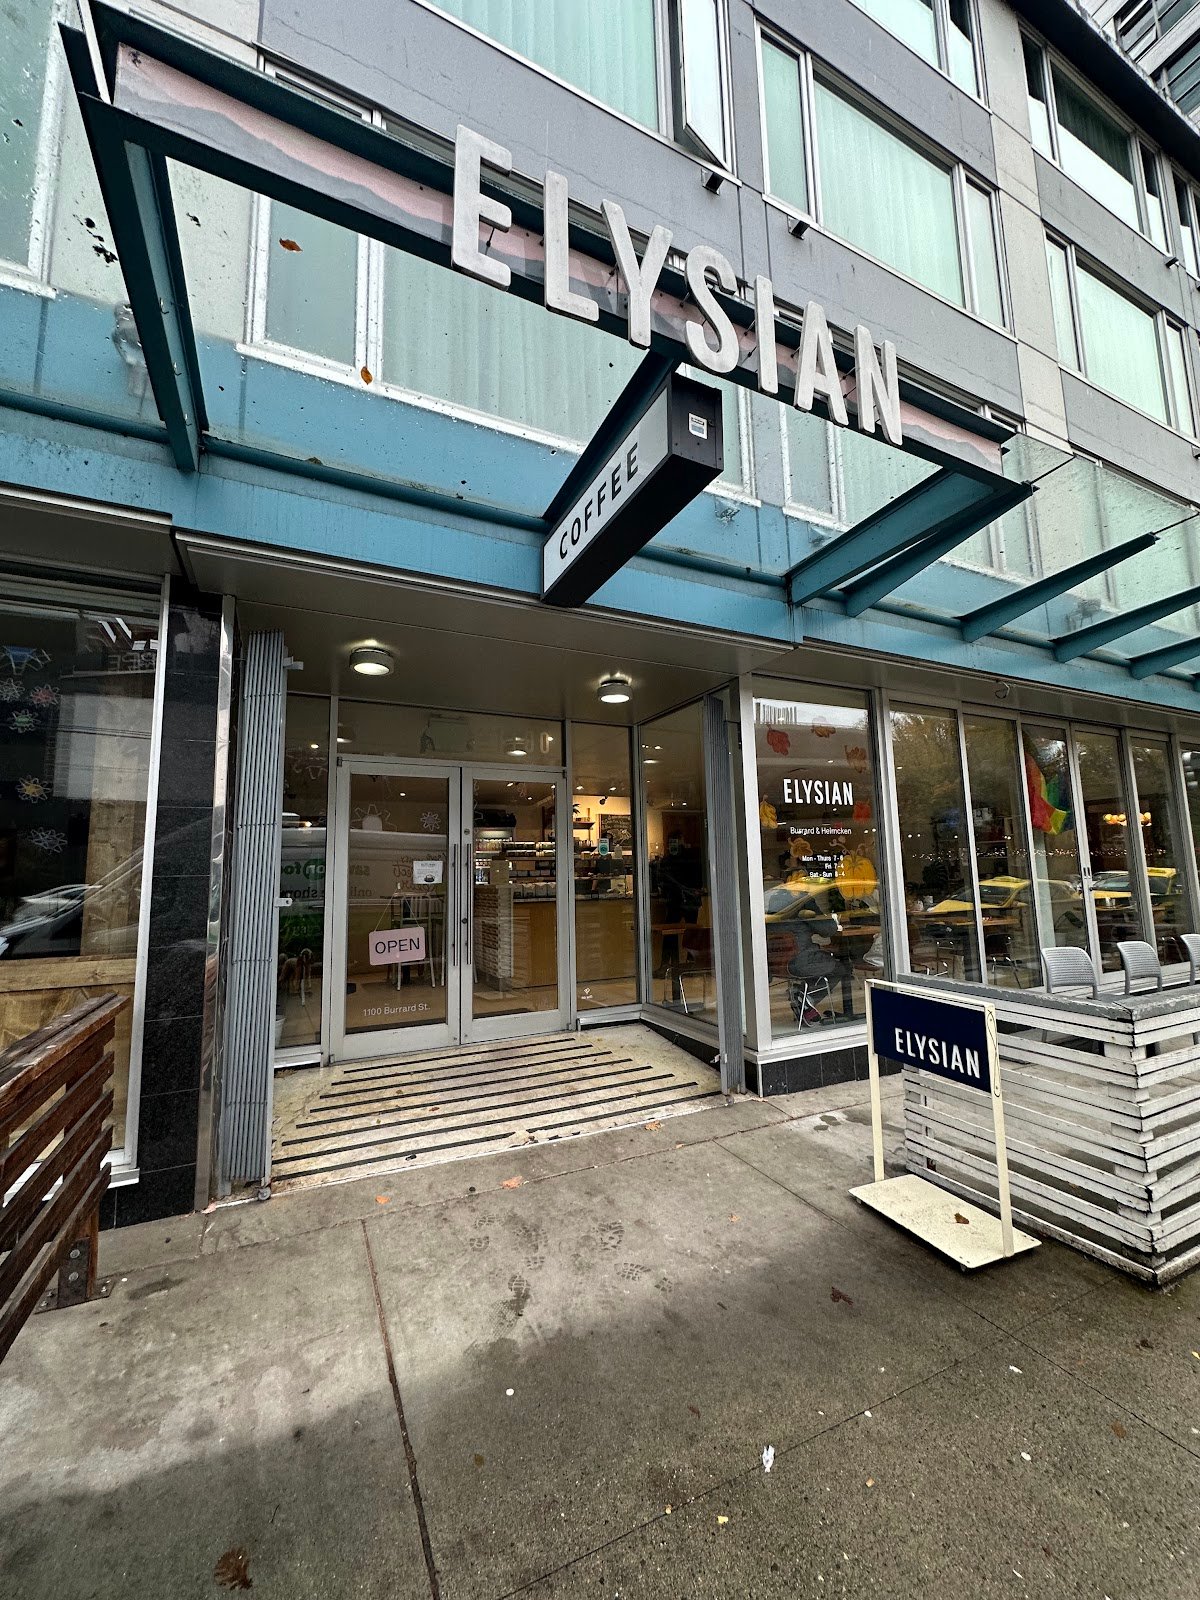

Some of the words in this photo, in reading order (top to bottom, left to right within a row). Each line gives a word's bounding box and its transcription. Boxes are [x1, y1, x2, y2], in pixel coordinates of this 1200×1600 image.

[451, 123, 903, 446] ELYSIAN
[558, 441, 640, 560] COFFEE
[783, 778, 854, 806] ELYSIAN
[821, 827, 852, 835] Helmcken
[375, 937, 420, 954] OPEN
[362, 1007, 382, 1017] 1100
[384, 1004, 416, 1015] Burrard
[894, 1027, 981, 1079] ELYSIAN
